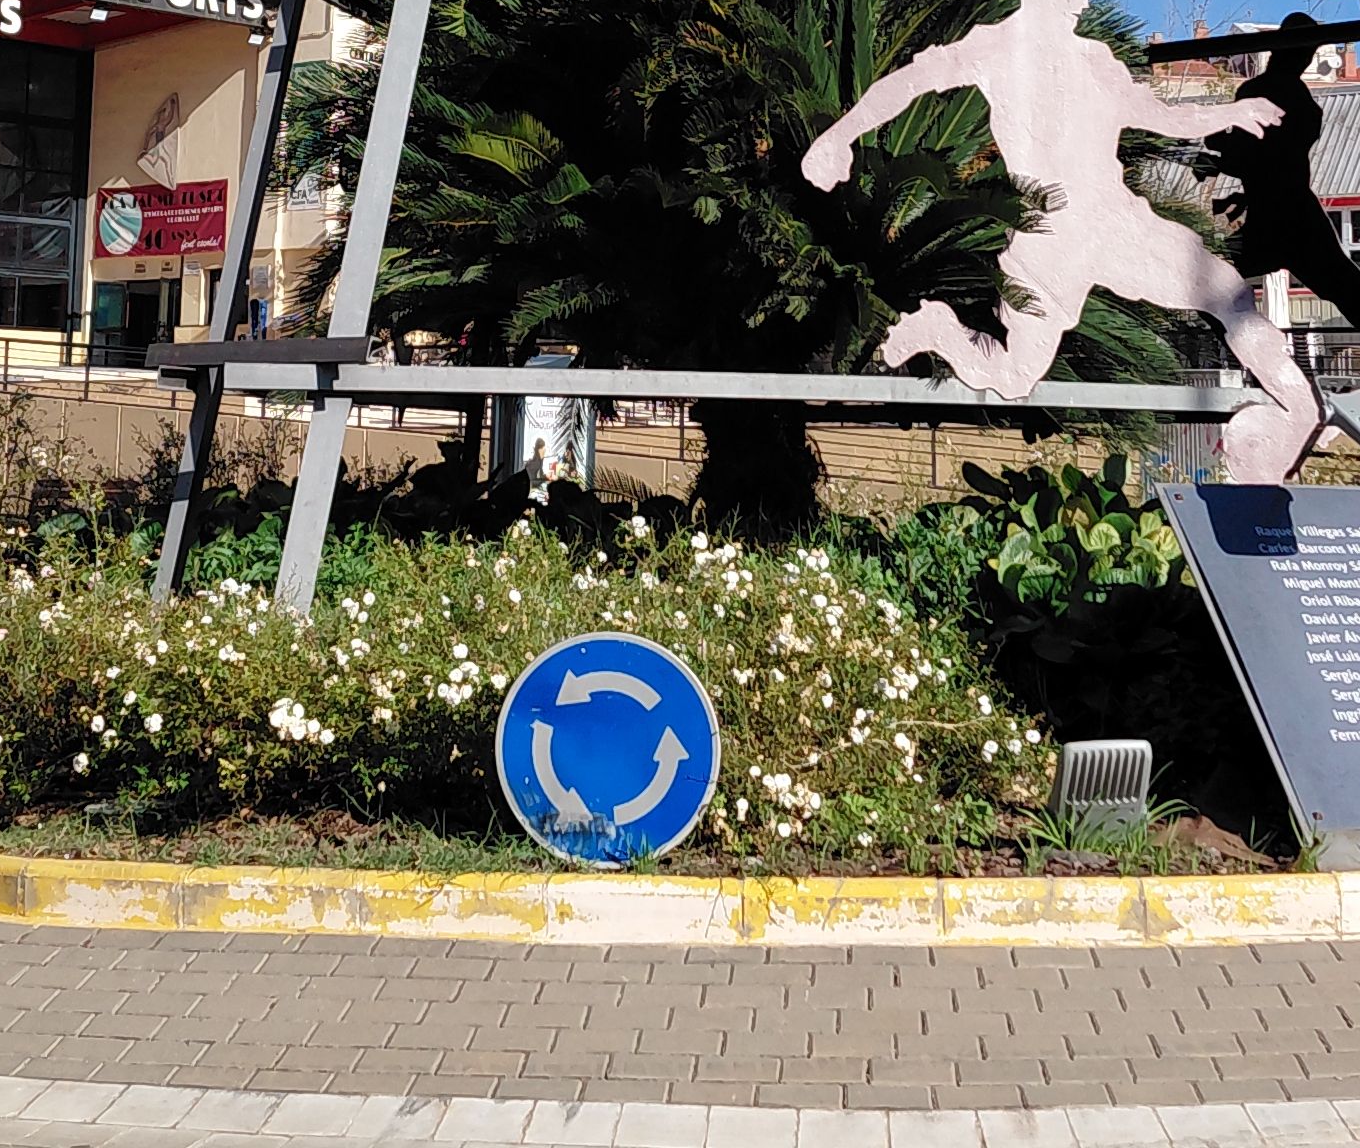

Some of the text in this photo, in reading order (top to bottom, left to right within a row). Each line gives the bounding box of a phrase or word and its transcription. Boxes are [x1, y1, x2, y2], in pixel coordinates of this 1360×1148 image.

[1254, 525, 1296, 540] Raque
[1297, 526, 1346, 540] Villegas
[1297, 543, 1345, 554] Barcons
[1269, 559, 1300, 572] Rafa
[1301, 560, 1348, 574] Monroy
[1282, 577, 1326, 591] Miguel
[1300, 595, 1333, 607] Oriol
[1301, 612, 1339, 625] David
[1305, 631, 1341, 645] Javier
[1306, 650, 1334, 664] José
